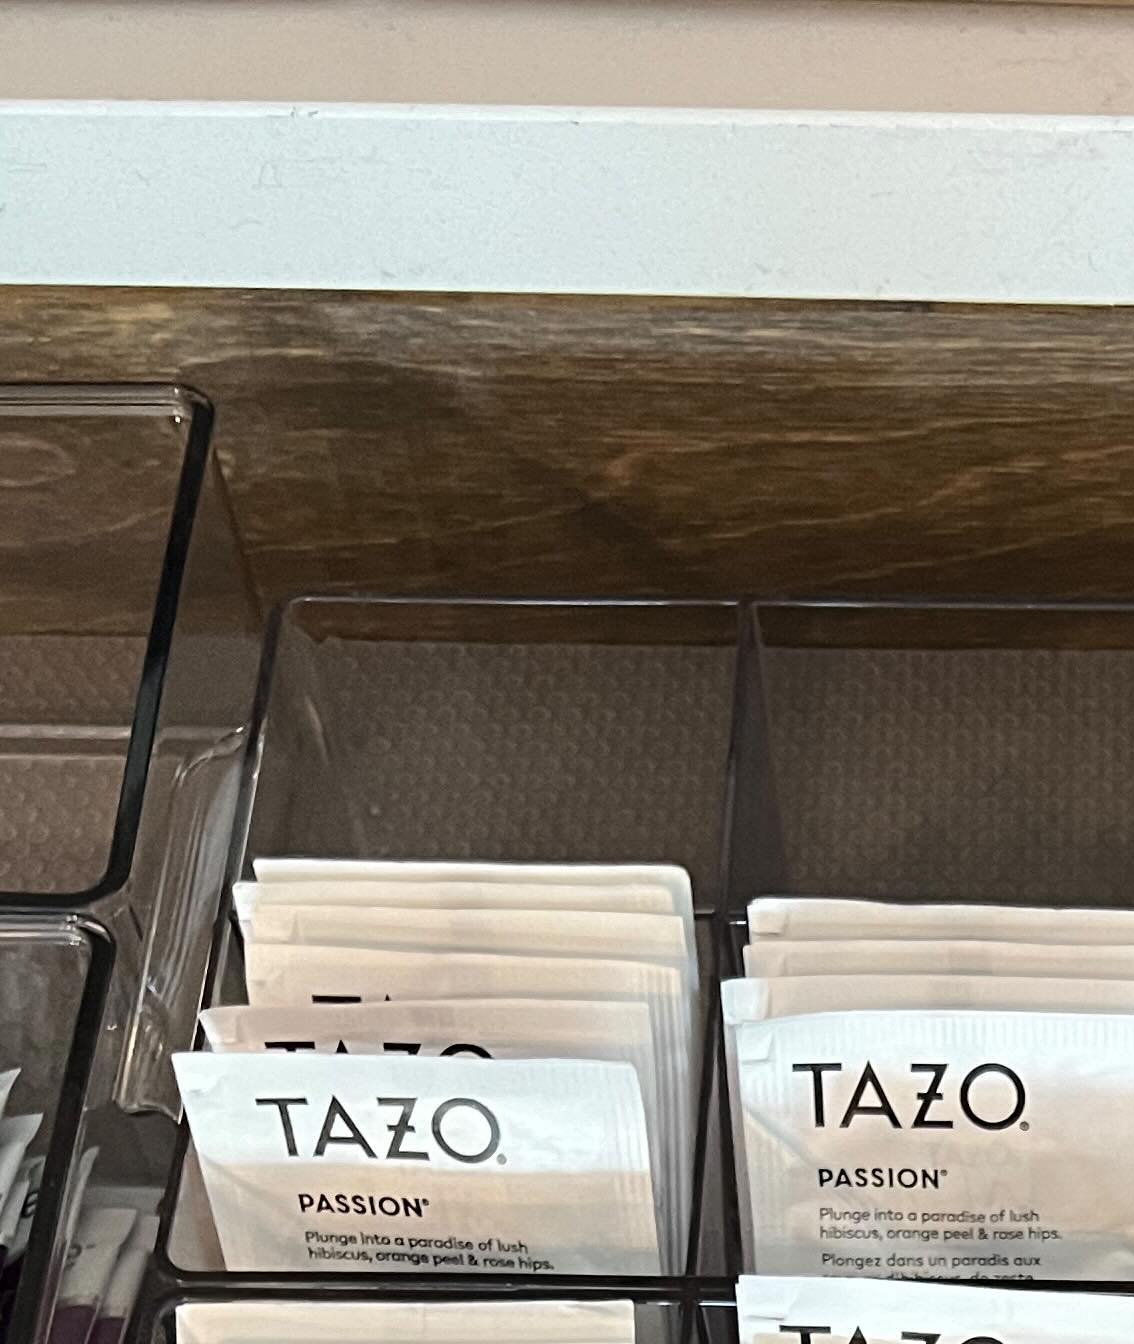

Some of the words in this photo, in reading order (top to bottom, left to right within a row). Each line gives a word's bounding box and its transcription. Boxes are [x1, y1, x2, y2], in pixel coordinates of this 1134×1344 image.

[819, 1208, 870, 1223] Plunge
[874, 1208, 902, 1222] into
[908, 1213, 917, 1222] a
[921, 1209, 986, 1224] paradise
[990, 1209, 1005, 1223] of
[1009, 1209, 1039, 1222] lush
